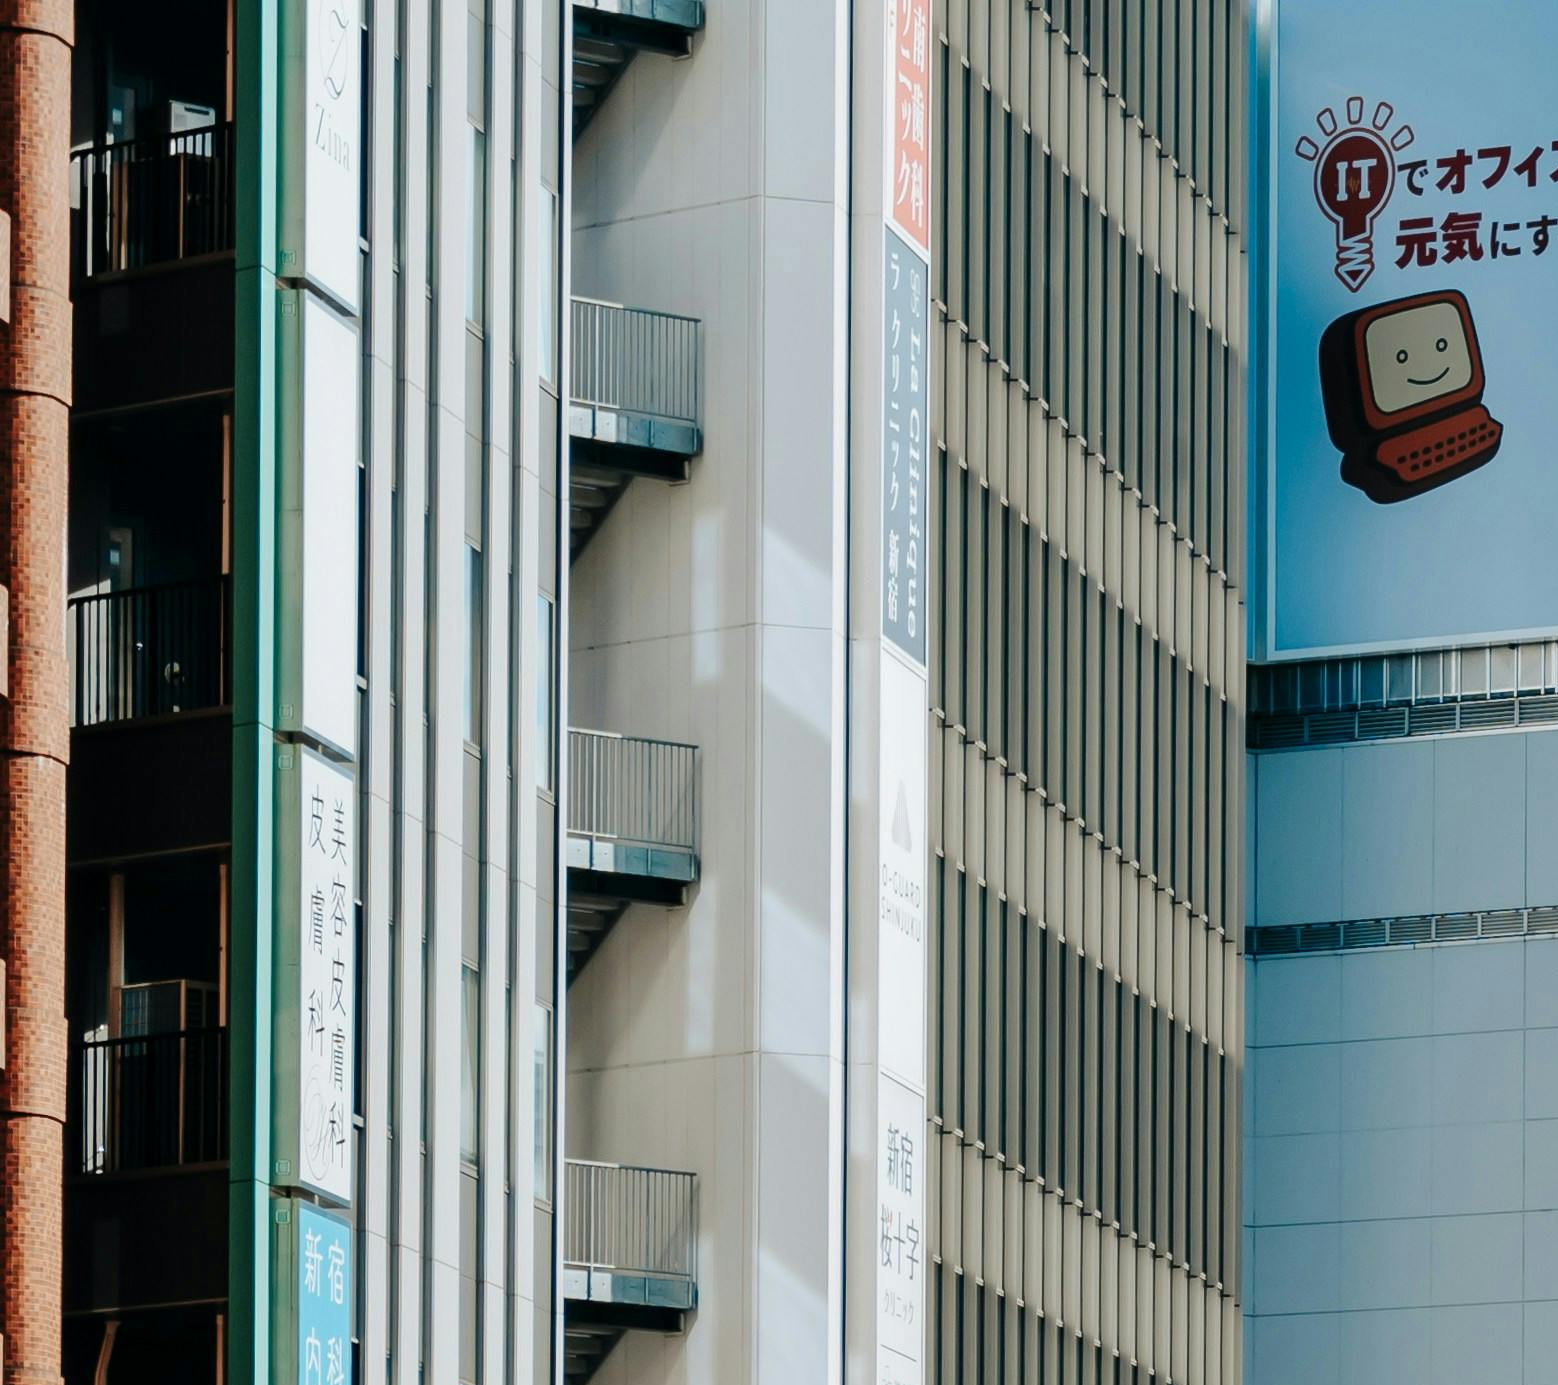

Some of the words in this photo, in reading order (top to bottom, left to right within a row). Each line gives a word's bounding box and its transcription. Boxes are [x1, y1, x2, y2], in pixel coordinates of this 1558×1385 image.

[907, 408, 921, 638] Clinique
[887, 529, 901, 624] 新宿
[307, 783, 327, 1057] 皮膚科
[328, 798, 347, 1170] 美容皮膚科
[886, 1120, 914, 1198] 新宿
[304, 1227, 345, 1305] 新宿
[880, 1203, 920, 1282] 桜十字
[883, 1286, 917, 1326] クリニック
